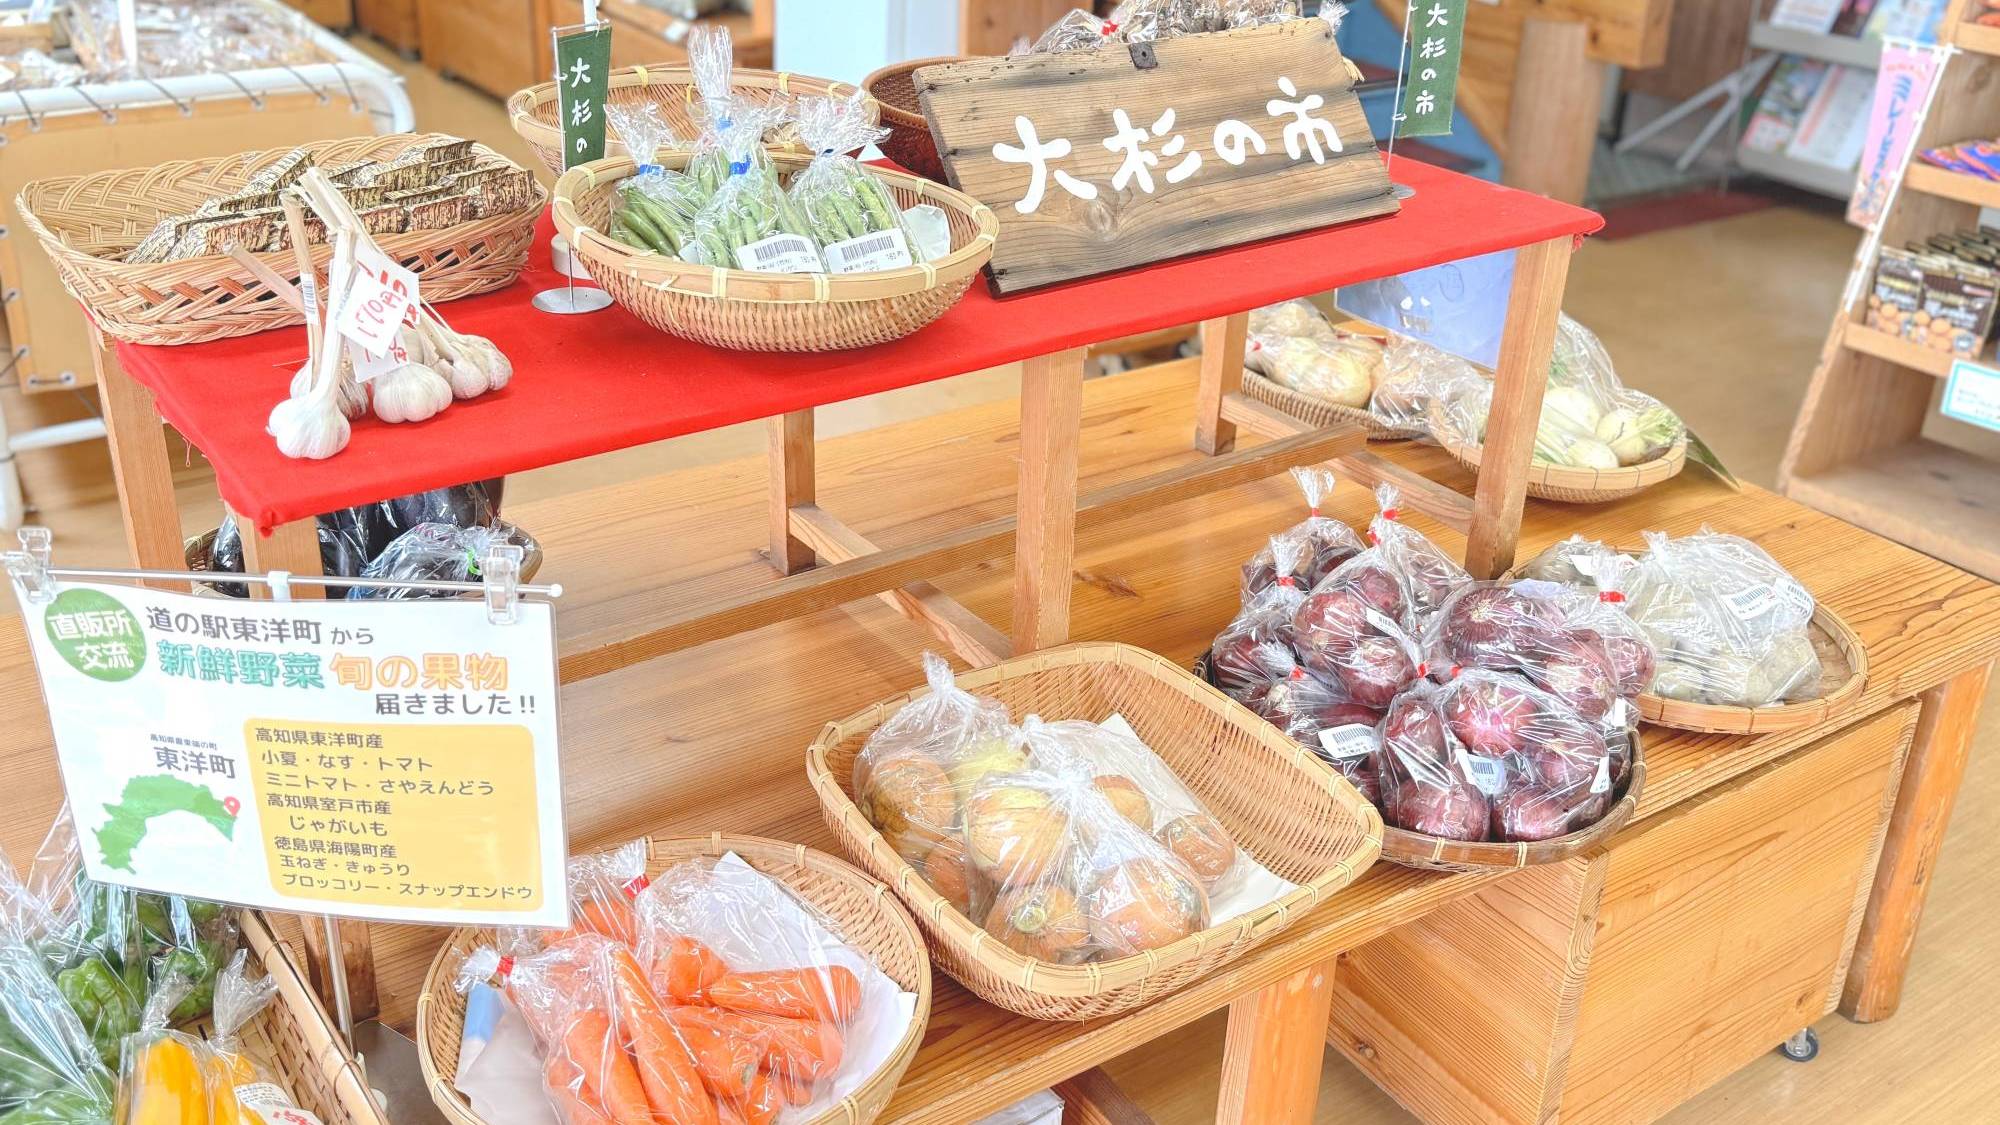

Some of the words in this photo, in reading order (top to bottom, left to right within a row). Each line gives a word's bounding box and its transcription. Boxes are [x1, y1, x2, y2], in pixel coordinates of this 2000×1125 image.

[1415, 3, 1448, 115] 大杉の市
[992, 77, 1343, 214] 大杉の市
[47, 609, 133, 641] 直販所
[75, 641, 135, 670] 交流
[255, 727, 384, 749] 高知県東洋町産
[153, 746, 236, 779] 東洋町
[266, 793, 392, 815] 高知県室戸市産
[289, 815, 388, 837] じゃがいも
[273, 835, 398, 859] 徳島県海陽町産
